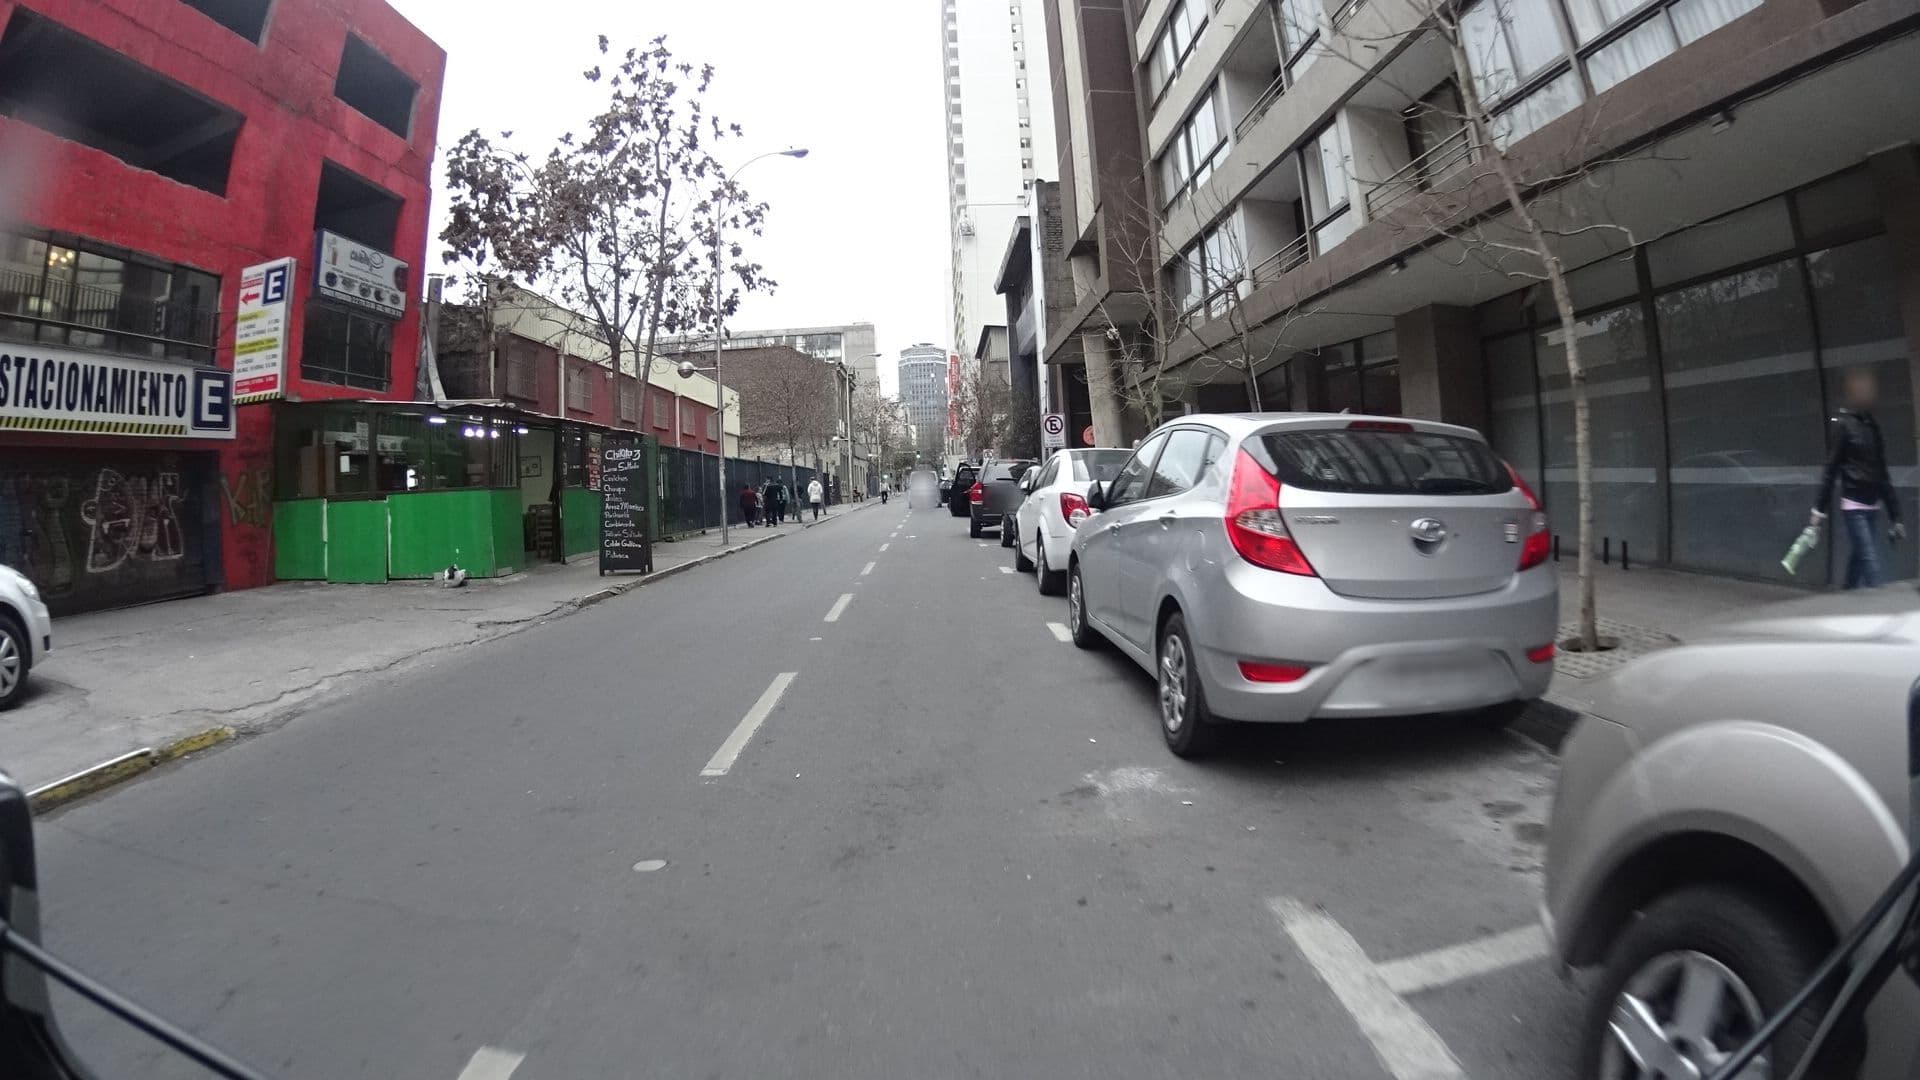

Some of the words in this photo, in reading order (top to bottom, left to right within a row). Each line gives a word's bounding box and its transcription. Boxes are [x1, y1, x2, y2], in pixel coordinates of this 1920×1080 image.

[267, 270, 284, 300] E
[0, 354, 187, 418] STACIONAMIENTO
[200, 379, 224, 422] E
